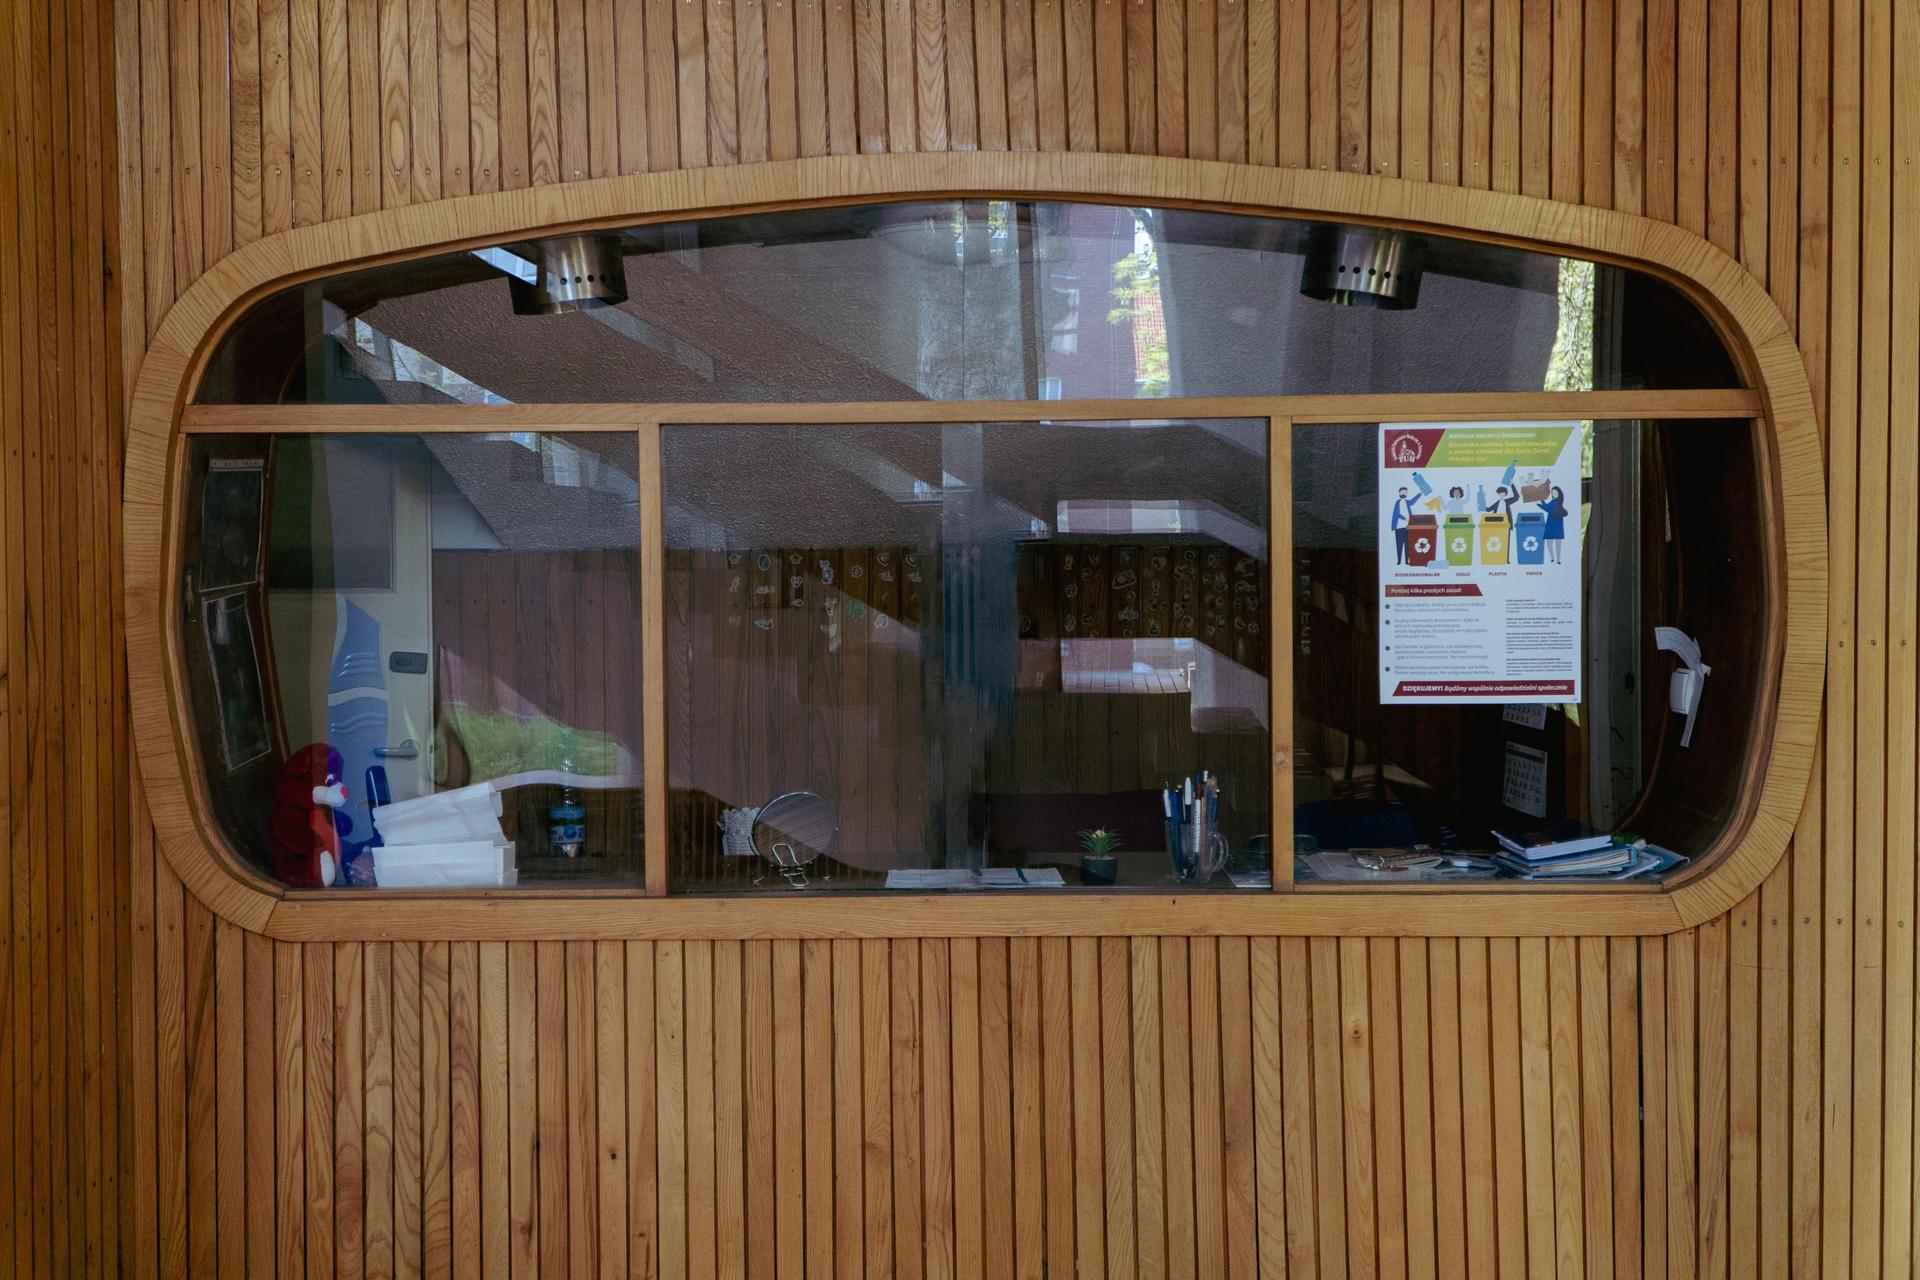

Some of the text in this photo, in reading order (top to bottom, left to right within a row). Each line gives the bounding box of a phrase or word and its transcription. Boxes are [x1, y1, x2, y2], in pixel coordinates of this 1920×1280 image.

[1423, 587, 1445, 595] prostych
[1468, 685, 1493, 693] wspólnie
[1538, 684, 1568, 692] społecznie
